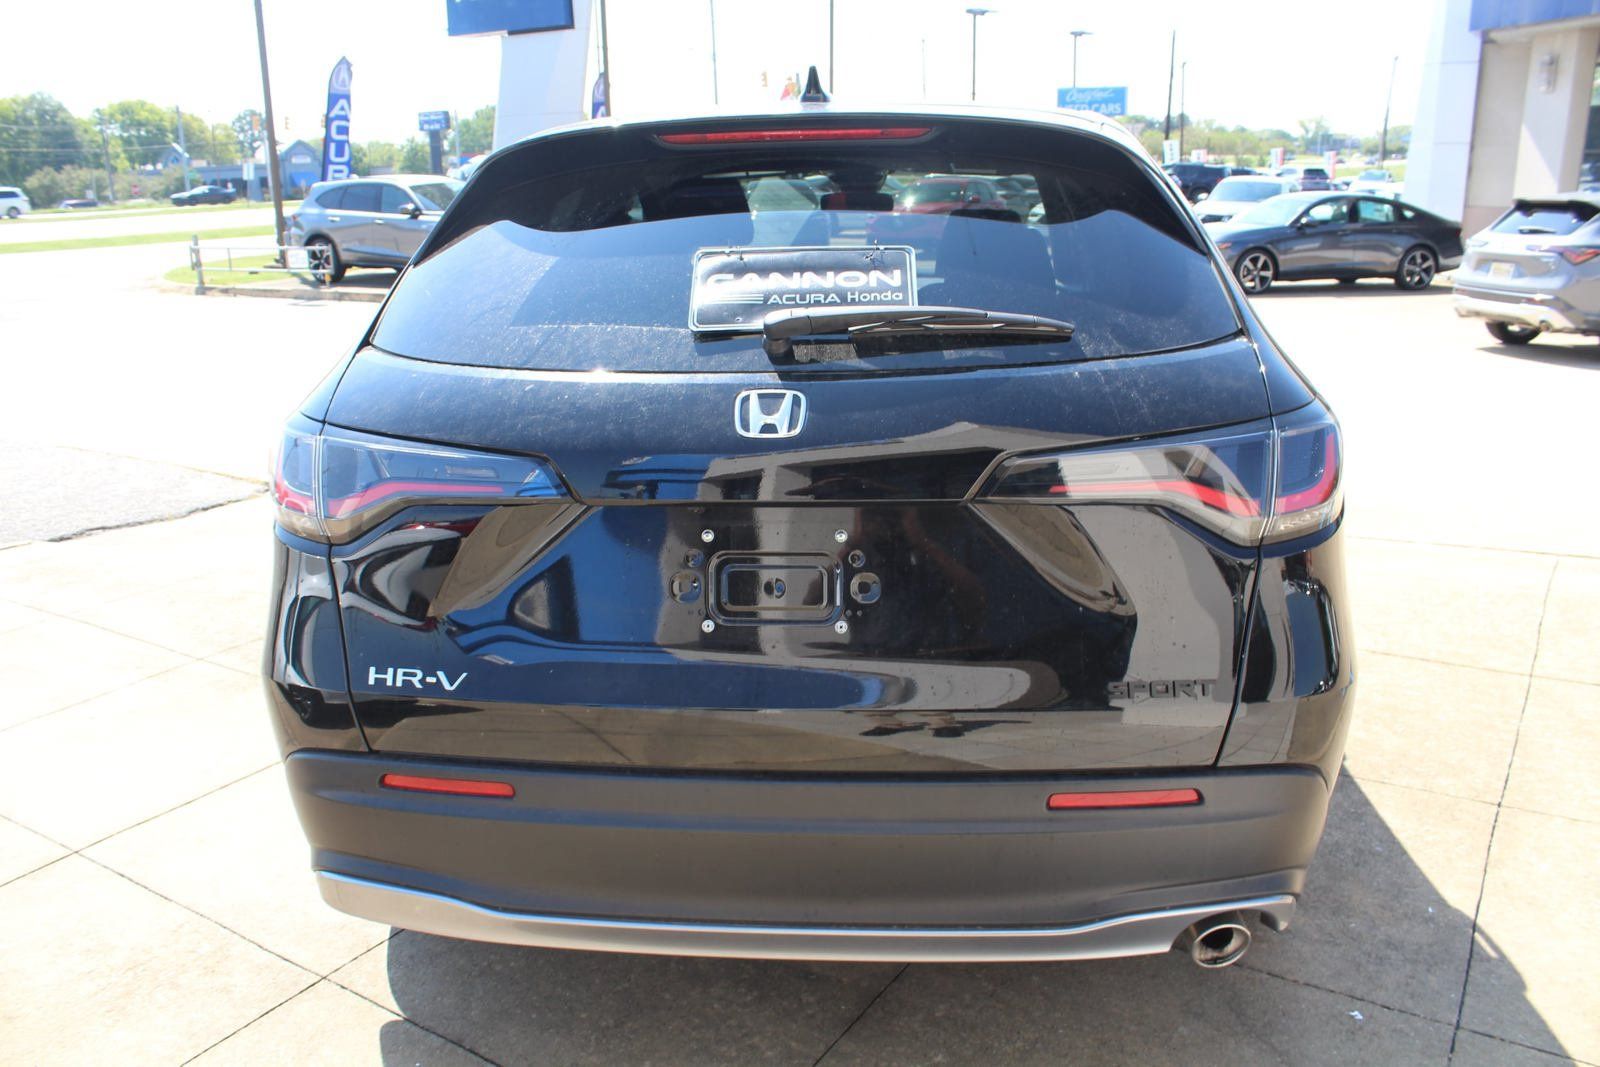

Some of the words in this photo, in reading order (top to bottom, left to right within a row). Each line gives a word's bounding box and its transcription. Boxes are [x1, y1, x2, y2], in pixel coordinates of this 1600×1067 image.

[1091, 102, 1121, 114] CARS
[328, 98, 351, 181] ACUR
[705, 269, 902, 289] CANNON
[767, 293, 840, 305] ACURA
[847, 290, 903, 303] Honda
[367, 665, 468, 691] HR-V
[1107, 679, 1217, 700] SPORT
